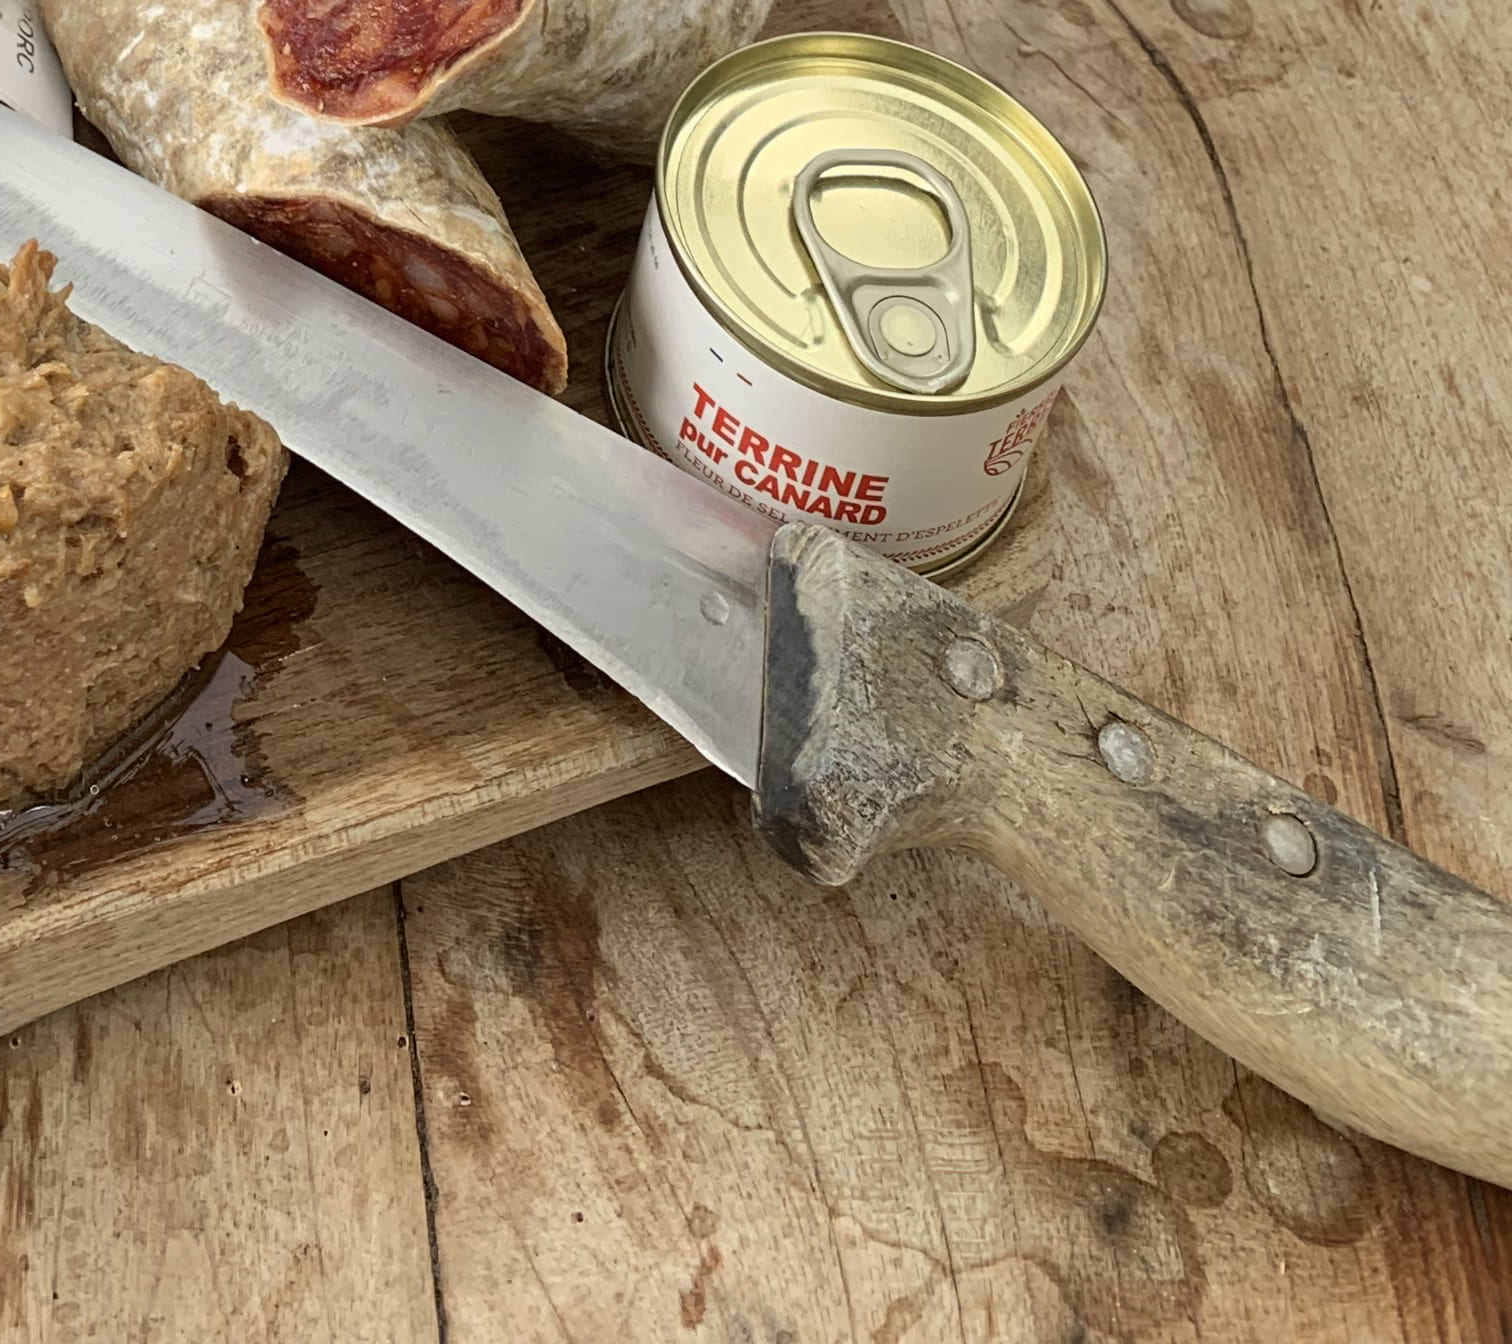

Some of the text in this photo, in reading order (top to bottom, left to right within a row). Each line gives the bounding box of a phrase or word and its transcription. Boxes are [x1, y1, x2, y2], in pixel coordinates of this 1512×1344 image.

[675, 439, 725, 490] FLEUR
[727, 486, 753, 507] DE
[757, 502, 788, 524] SEL
[679, 416, 887, 526] pur CANARD
[693, 382, 890, 502] TERRINE
